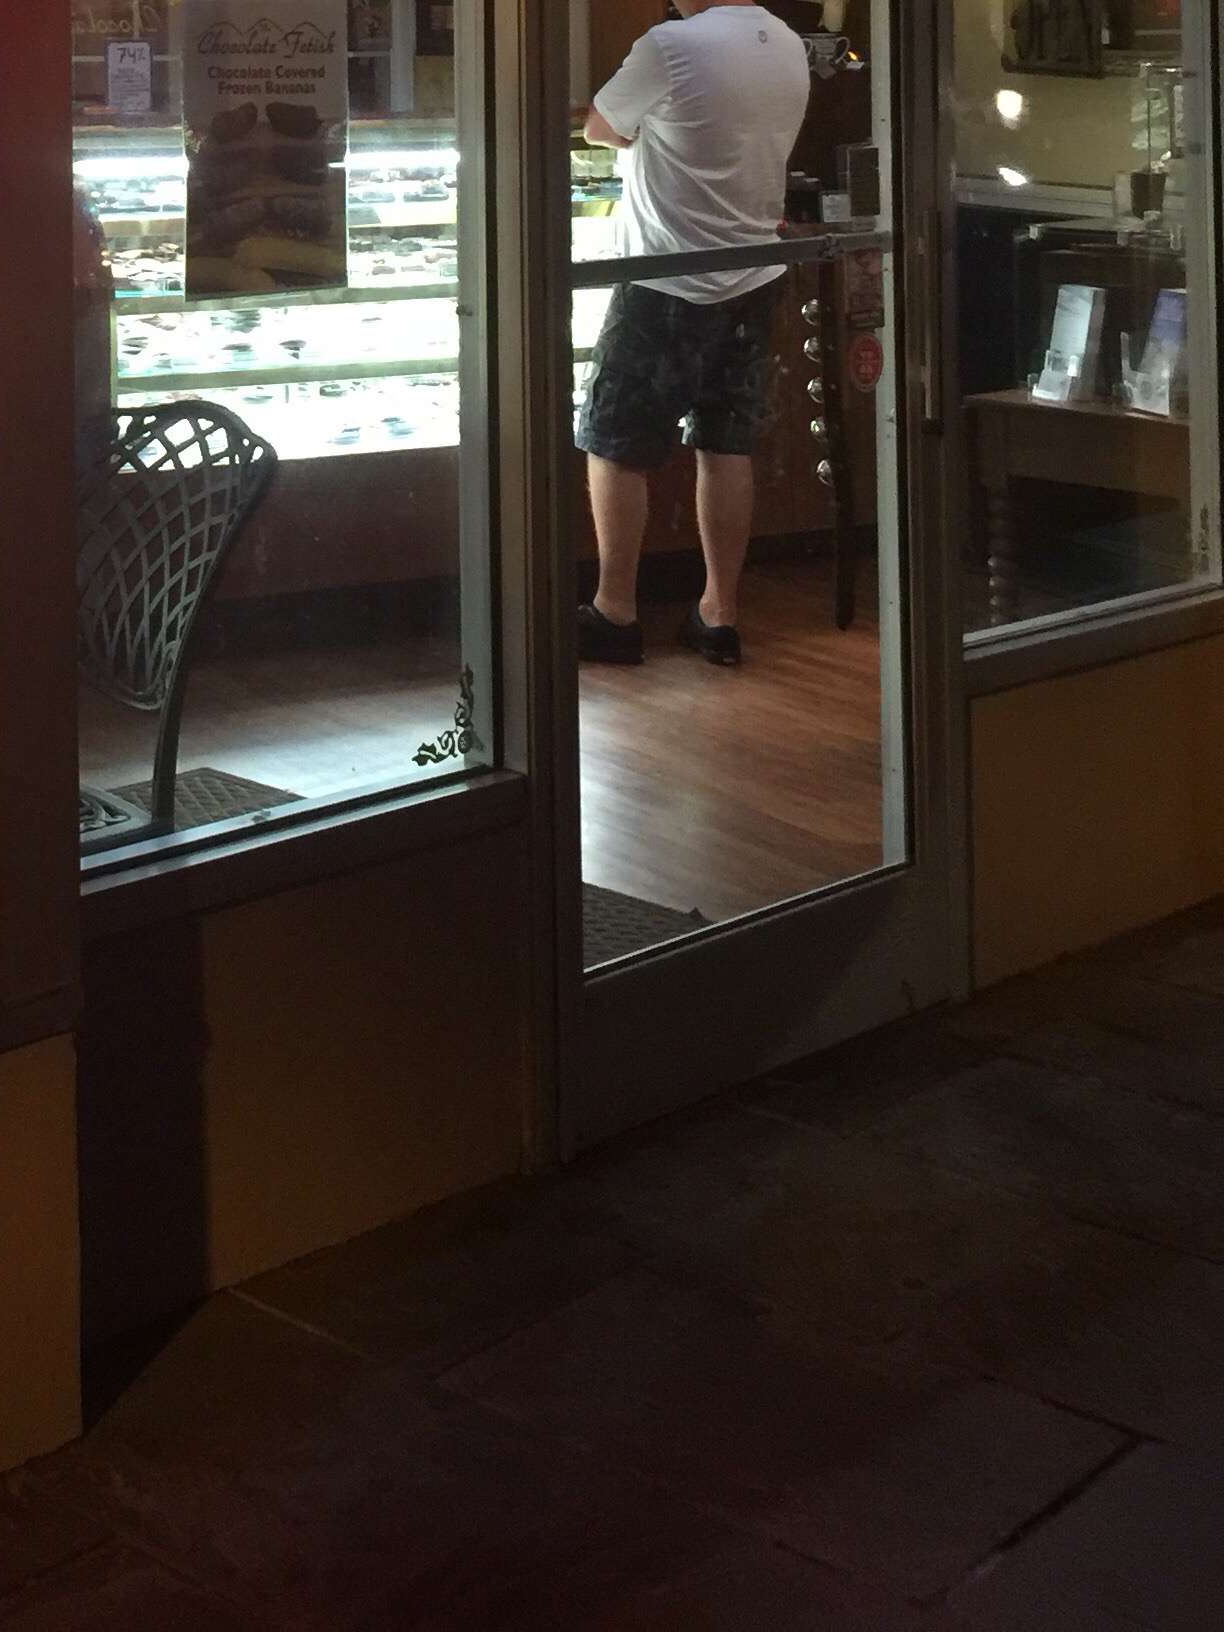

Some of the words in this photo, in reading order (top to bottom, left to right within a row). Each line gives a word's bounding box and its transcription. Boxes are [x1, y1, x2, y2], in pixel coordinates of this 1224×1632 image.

[197, 29, 276, 54] Chocolate
[278, 30, 336, 58] Fetish
[207, 64, 271, 79] Chocolate
[275, 64, 325, 79] Covered
[217, 80, 262, 95] Frozen
[265, 80, 316, 95] Bananas
